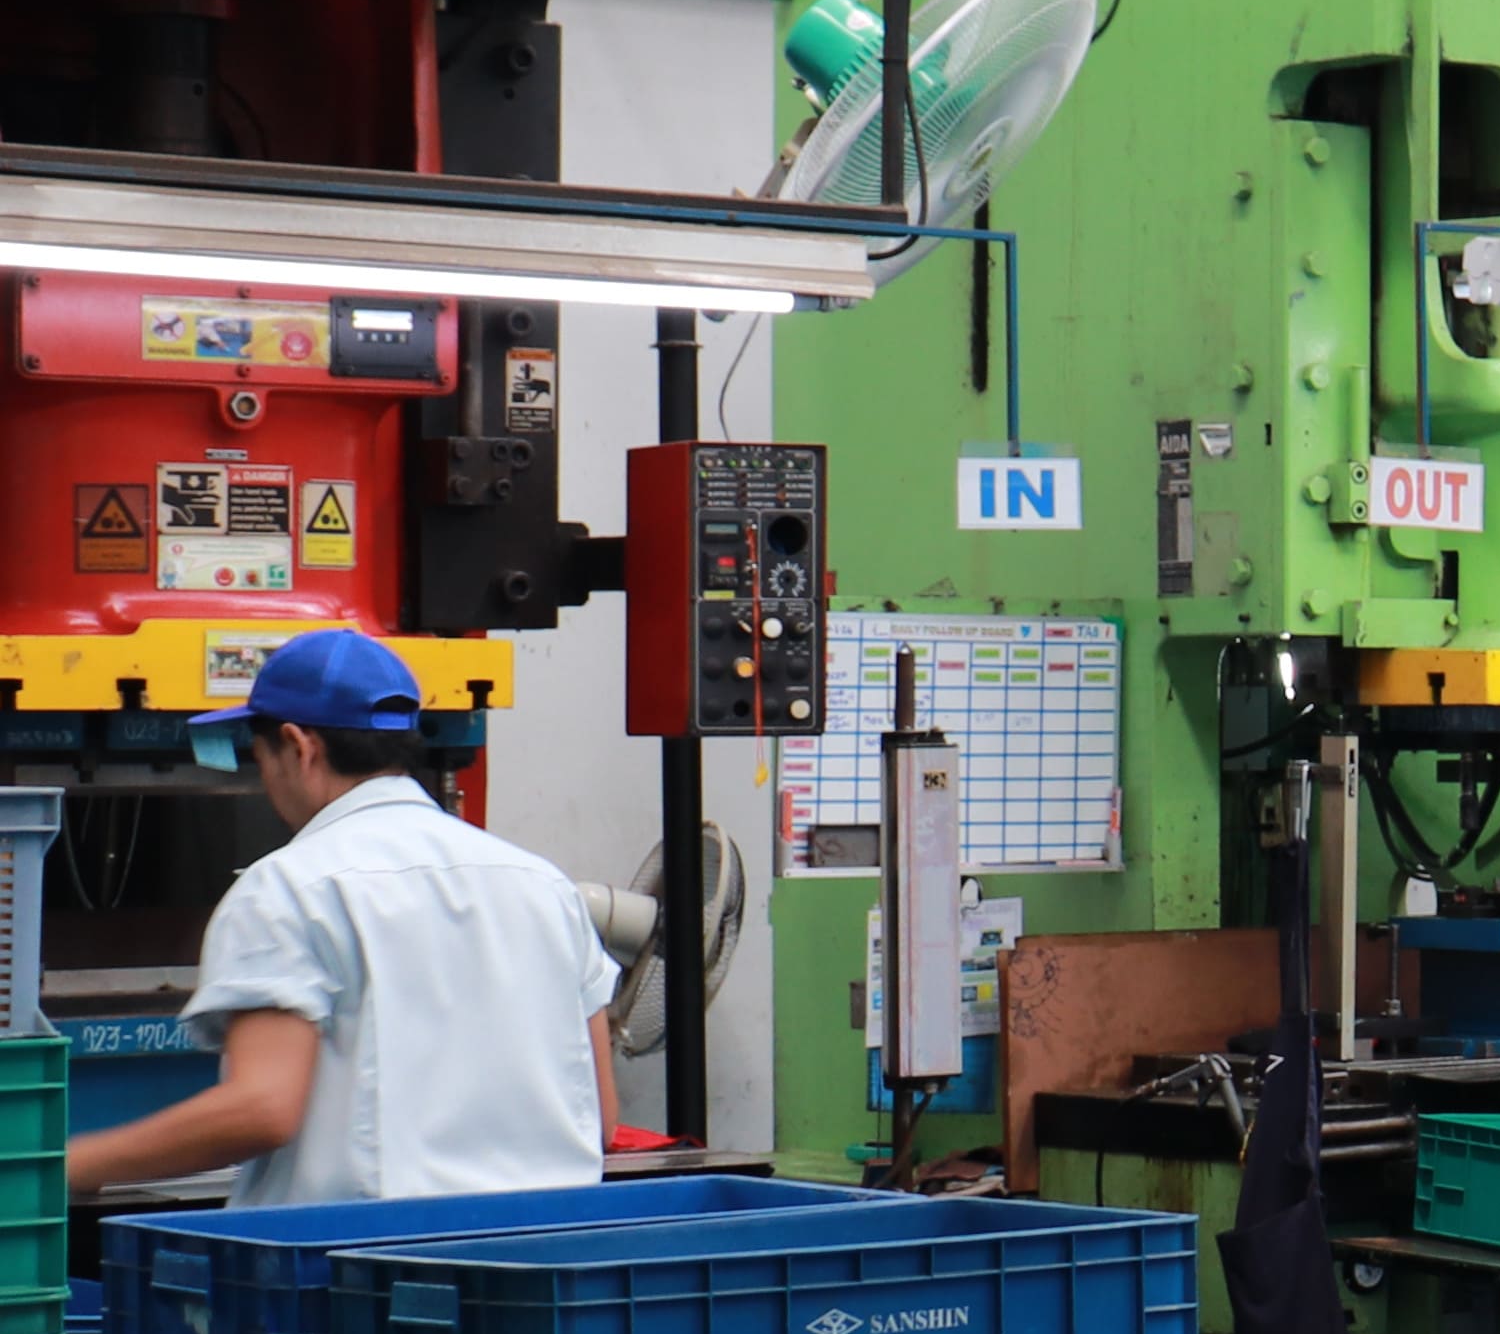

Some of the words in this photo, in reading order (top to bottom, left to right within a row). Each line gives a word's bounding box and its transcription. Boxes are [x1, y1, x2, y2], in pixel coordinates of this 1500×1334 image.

[1159, 431, 1190, 455] AIDA
[979, 468, 1056, 519] IN
[1385, 467, 1468, 522] OUT
[870, 1306, 969, 1334] SANSHIN
